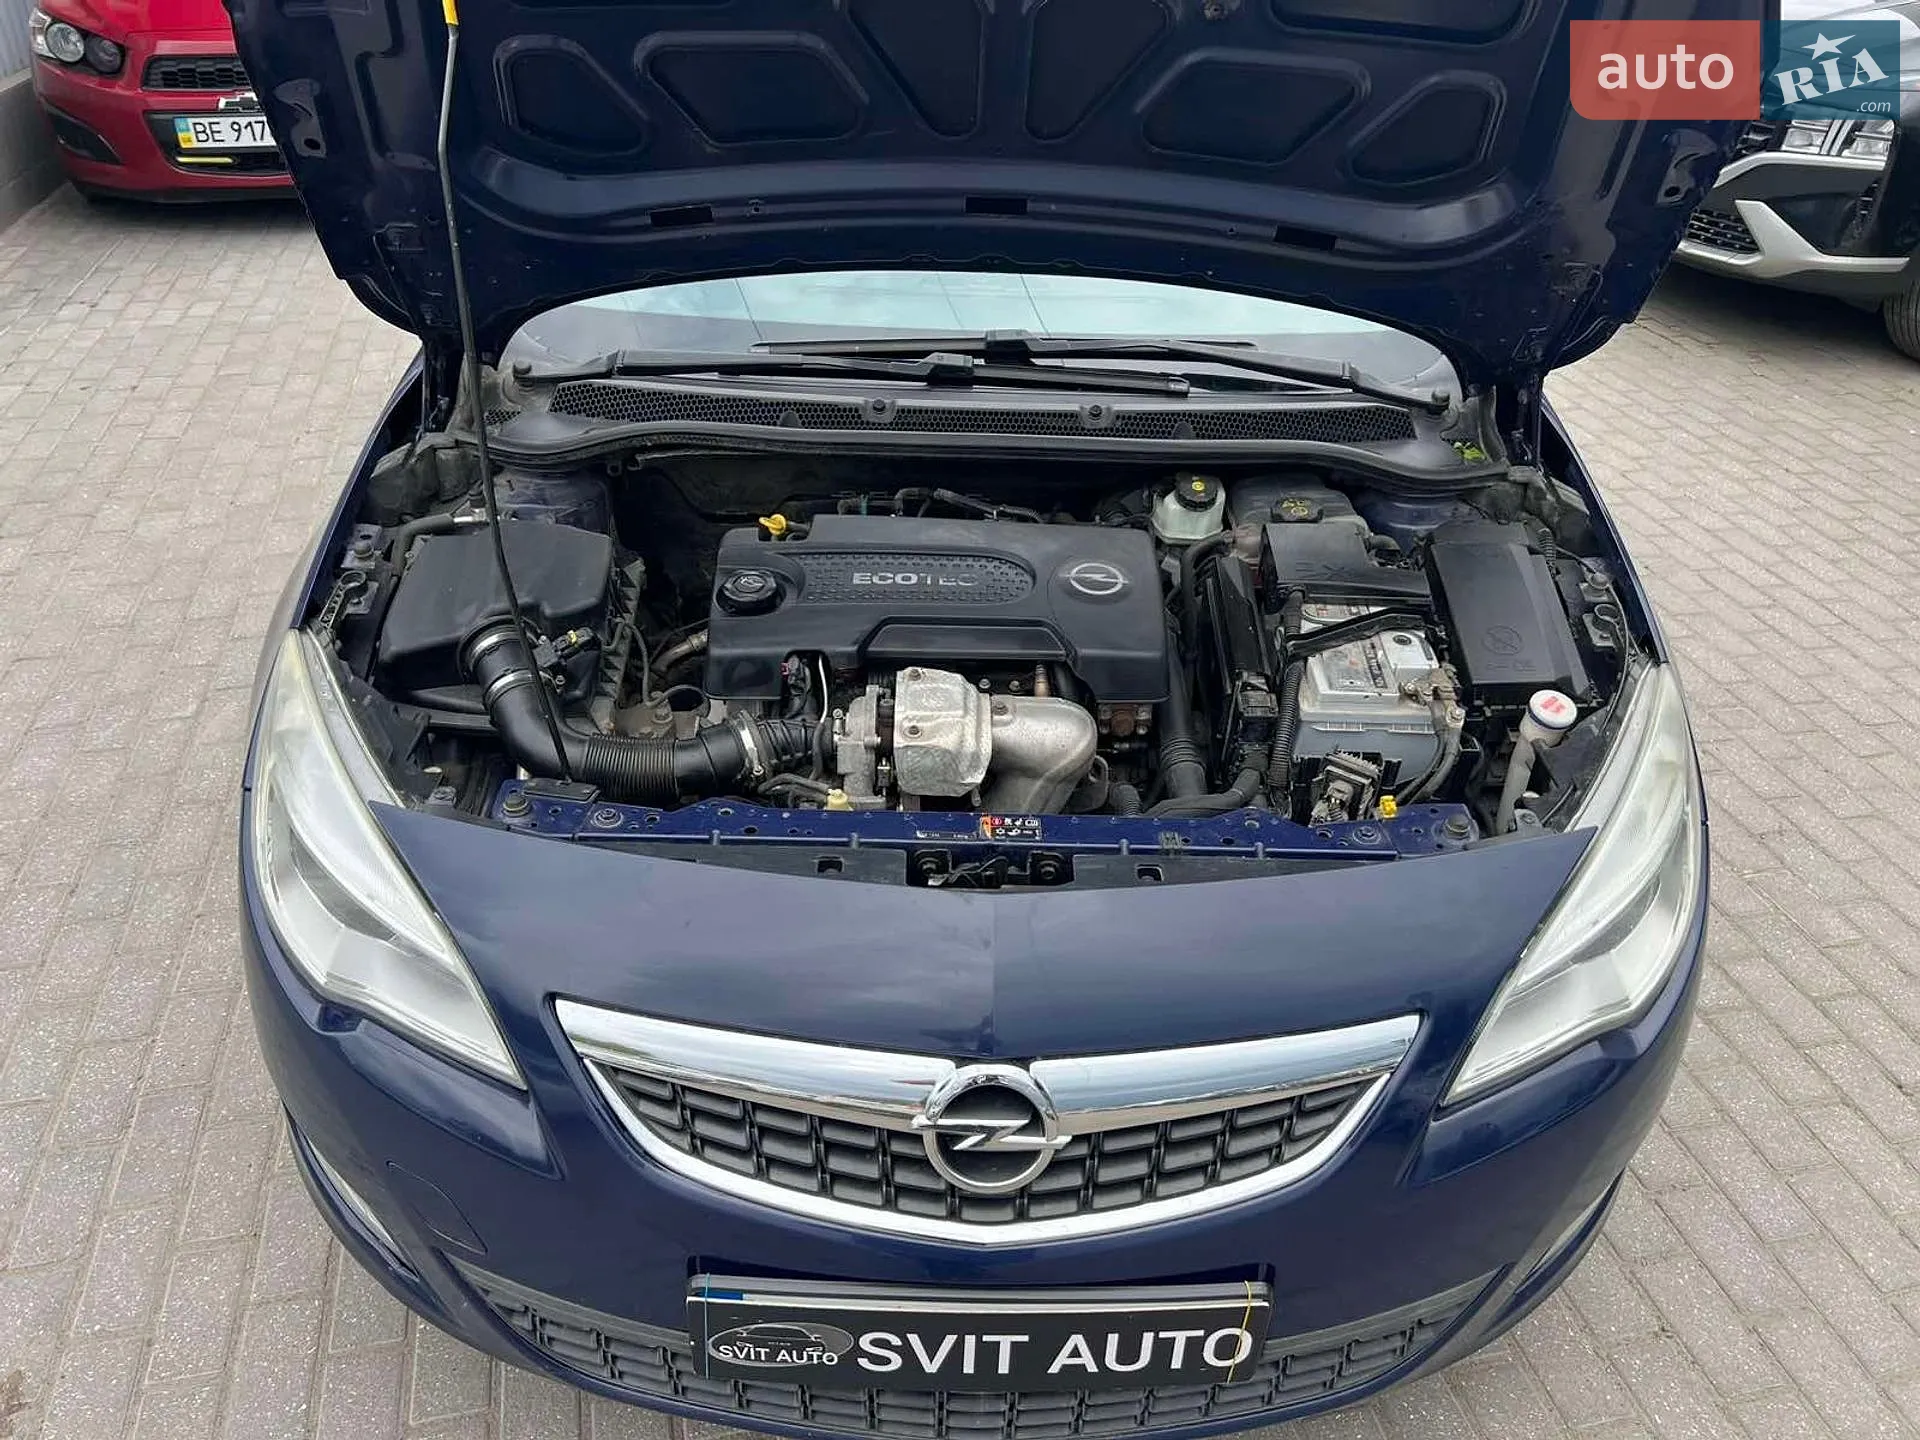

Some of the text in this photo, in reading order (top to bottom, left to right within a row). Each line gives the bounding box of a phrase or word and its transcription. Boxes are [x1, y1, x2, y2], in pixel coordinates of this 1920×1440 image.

[192, 121, 225, 143] BE
[852, 572, 979, 586] ECOTEC
[719, 1344, 839, 1366] SVIT AUTO
[857, 1327, 1253, 1375] SVIT AUTO
